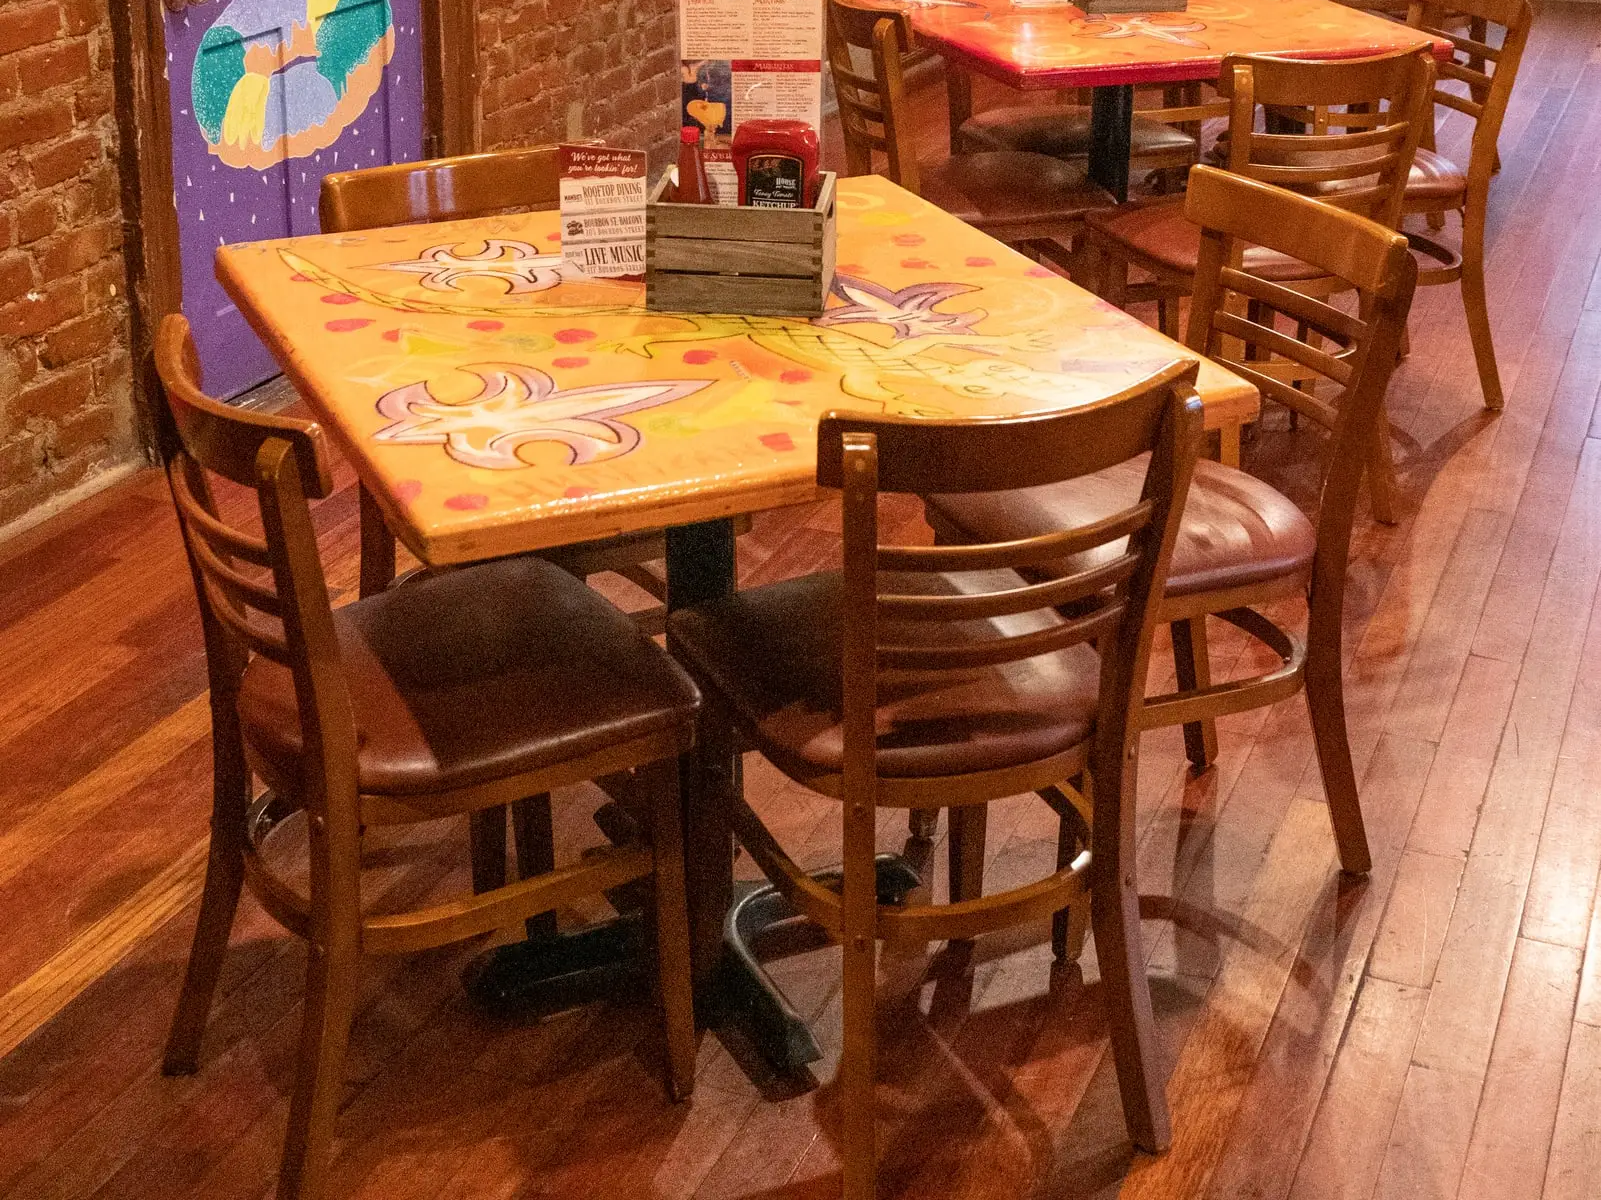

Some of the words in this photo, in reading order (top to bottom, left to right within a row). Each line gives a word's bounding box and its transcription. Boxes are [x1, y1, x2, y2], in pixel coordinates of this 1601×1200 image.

[570, 152, 596, 162] We've
[597, 154, 610, 163] got
[611, 153, 631, 162] what
[568, 163, 592, 173] you're
[594, 163, 620, 173] lookin'
[621, 164, 638, 175] for!
[775, 177, 796, 186] HOUSE
[582, 184, 615, 198] ROOFTOP
[616, 181, 642, 195] DINING
[752, 200, 796, 209] KETCHUP
[584, 247, 608, 266] LIVE
[609, 244, 644, 264] MUSIC
